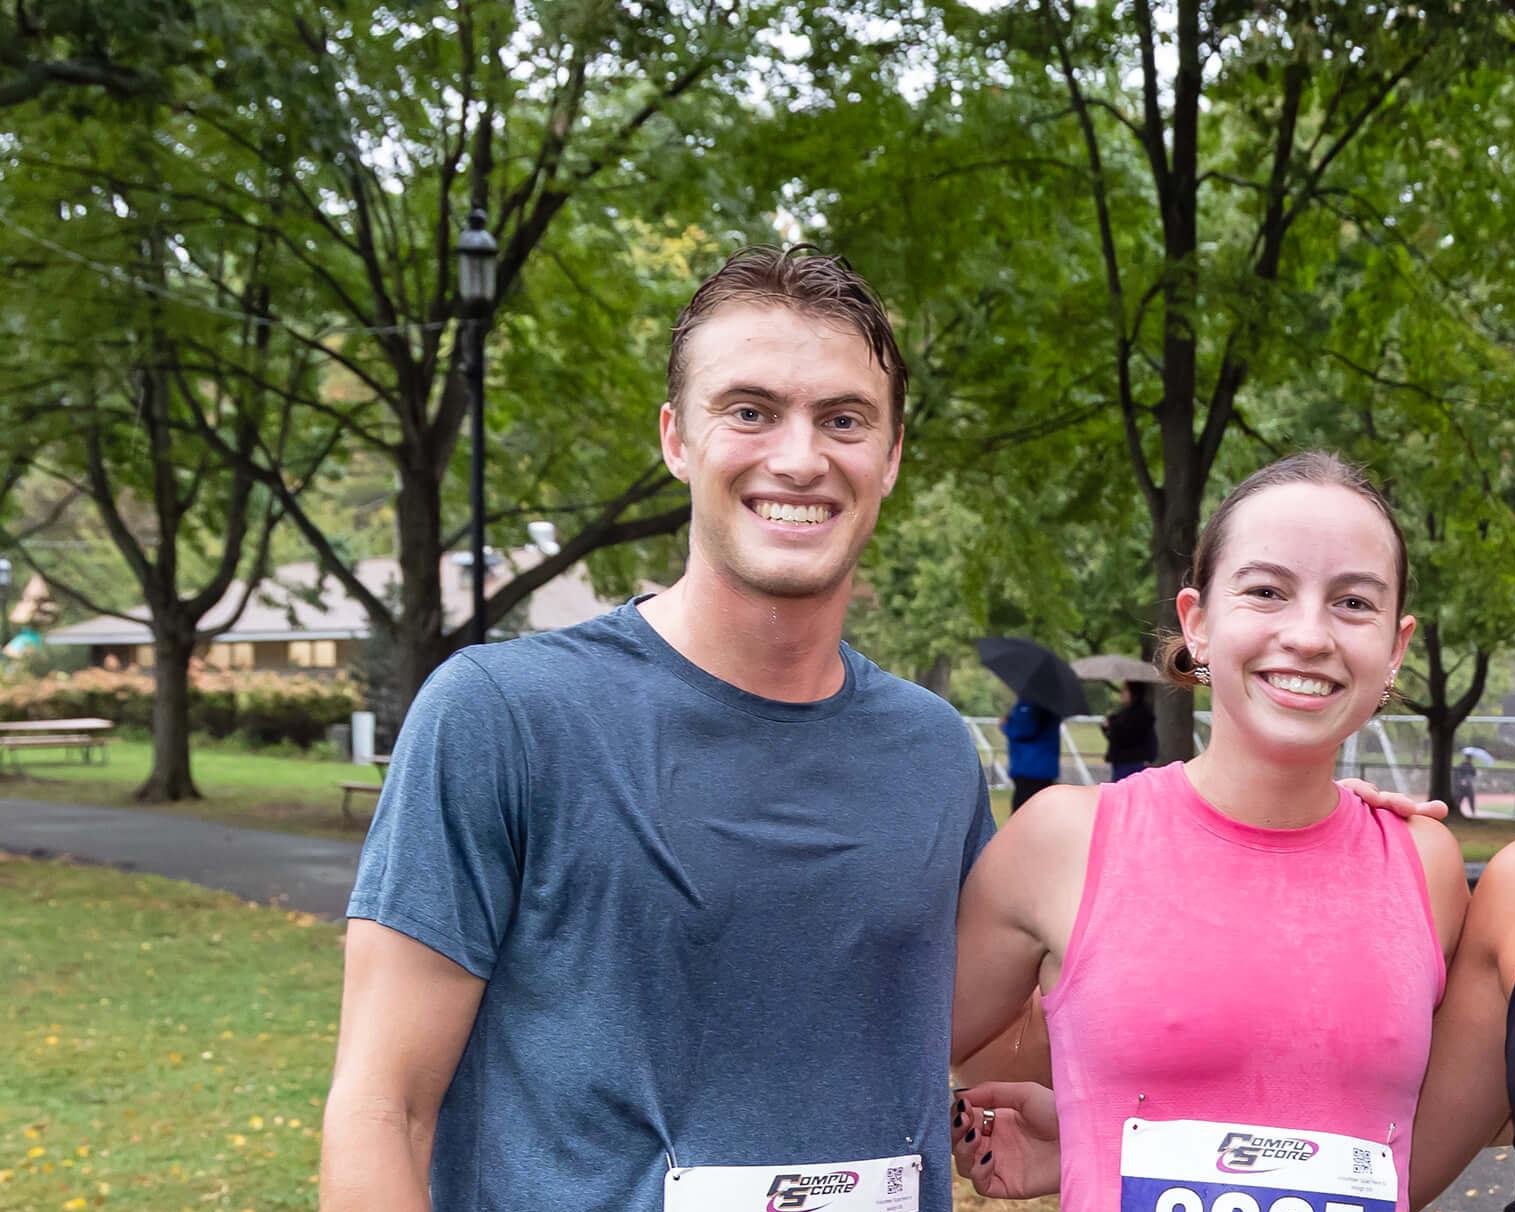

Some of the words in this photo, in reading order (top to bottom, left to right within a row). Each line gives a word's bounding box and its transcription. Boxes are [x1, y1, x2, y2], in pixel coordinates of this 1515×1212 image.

[1217, 1132, 1307, 1153] COMPU
[1230, 1145, 1312, 1166] SCORE
[766, 1173, 848, 1197] COMPU
[780, 1182, 855, 1208] SCORE
